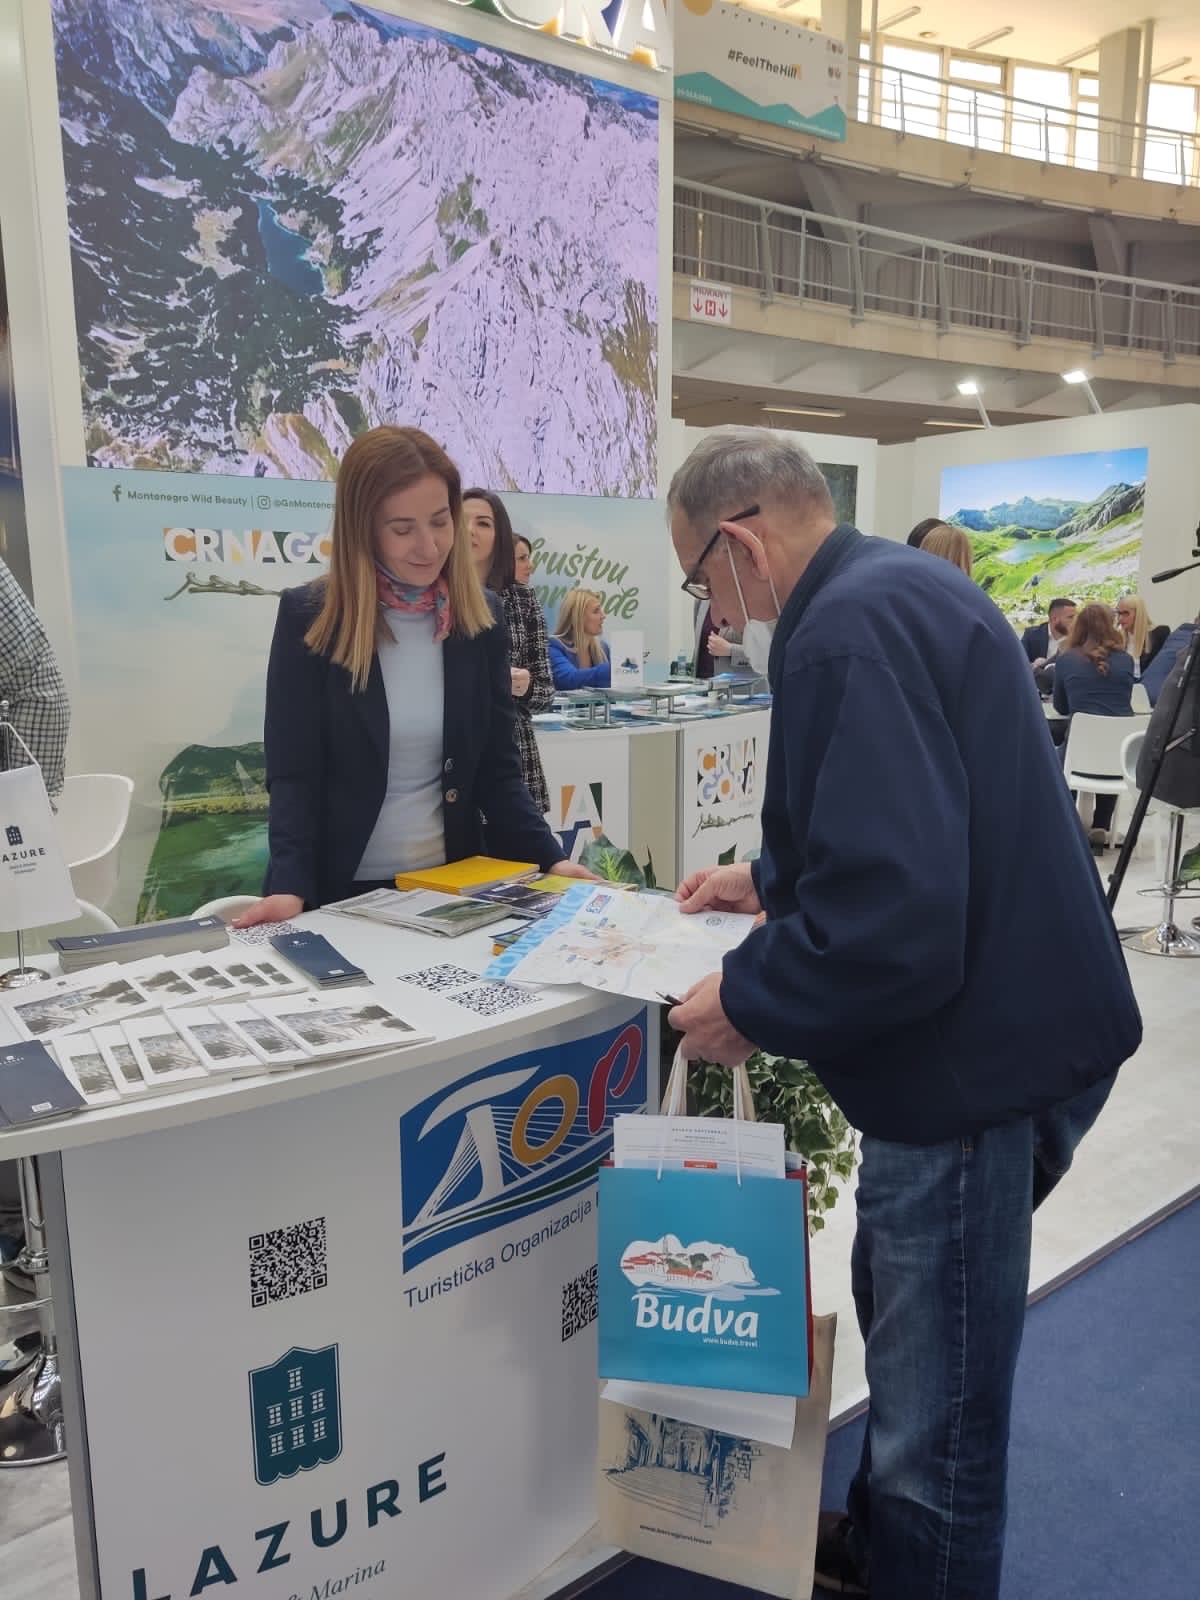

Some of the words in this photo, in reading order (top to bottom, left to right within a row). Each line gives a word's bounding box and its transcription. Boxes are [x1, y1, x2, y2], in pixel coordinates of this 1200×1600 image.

[727, 48, 798, 80] #FeelTheHill
[127, 490, 189, 504] Montenegro
[191, 490, 213, 505] Wild
[215, 495, 248, 508] Beauty
[403, 1255, 495, 1308] Turistička
[500, 1199, 593, 1262] Organizacija
[631, 1292, 759, 1338] Budva
[131, 1451, 447, 1600] LAZURE
[310, 1559, 387, 1600] Marina
